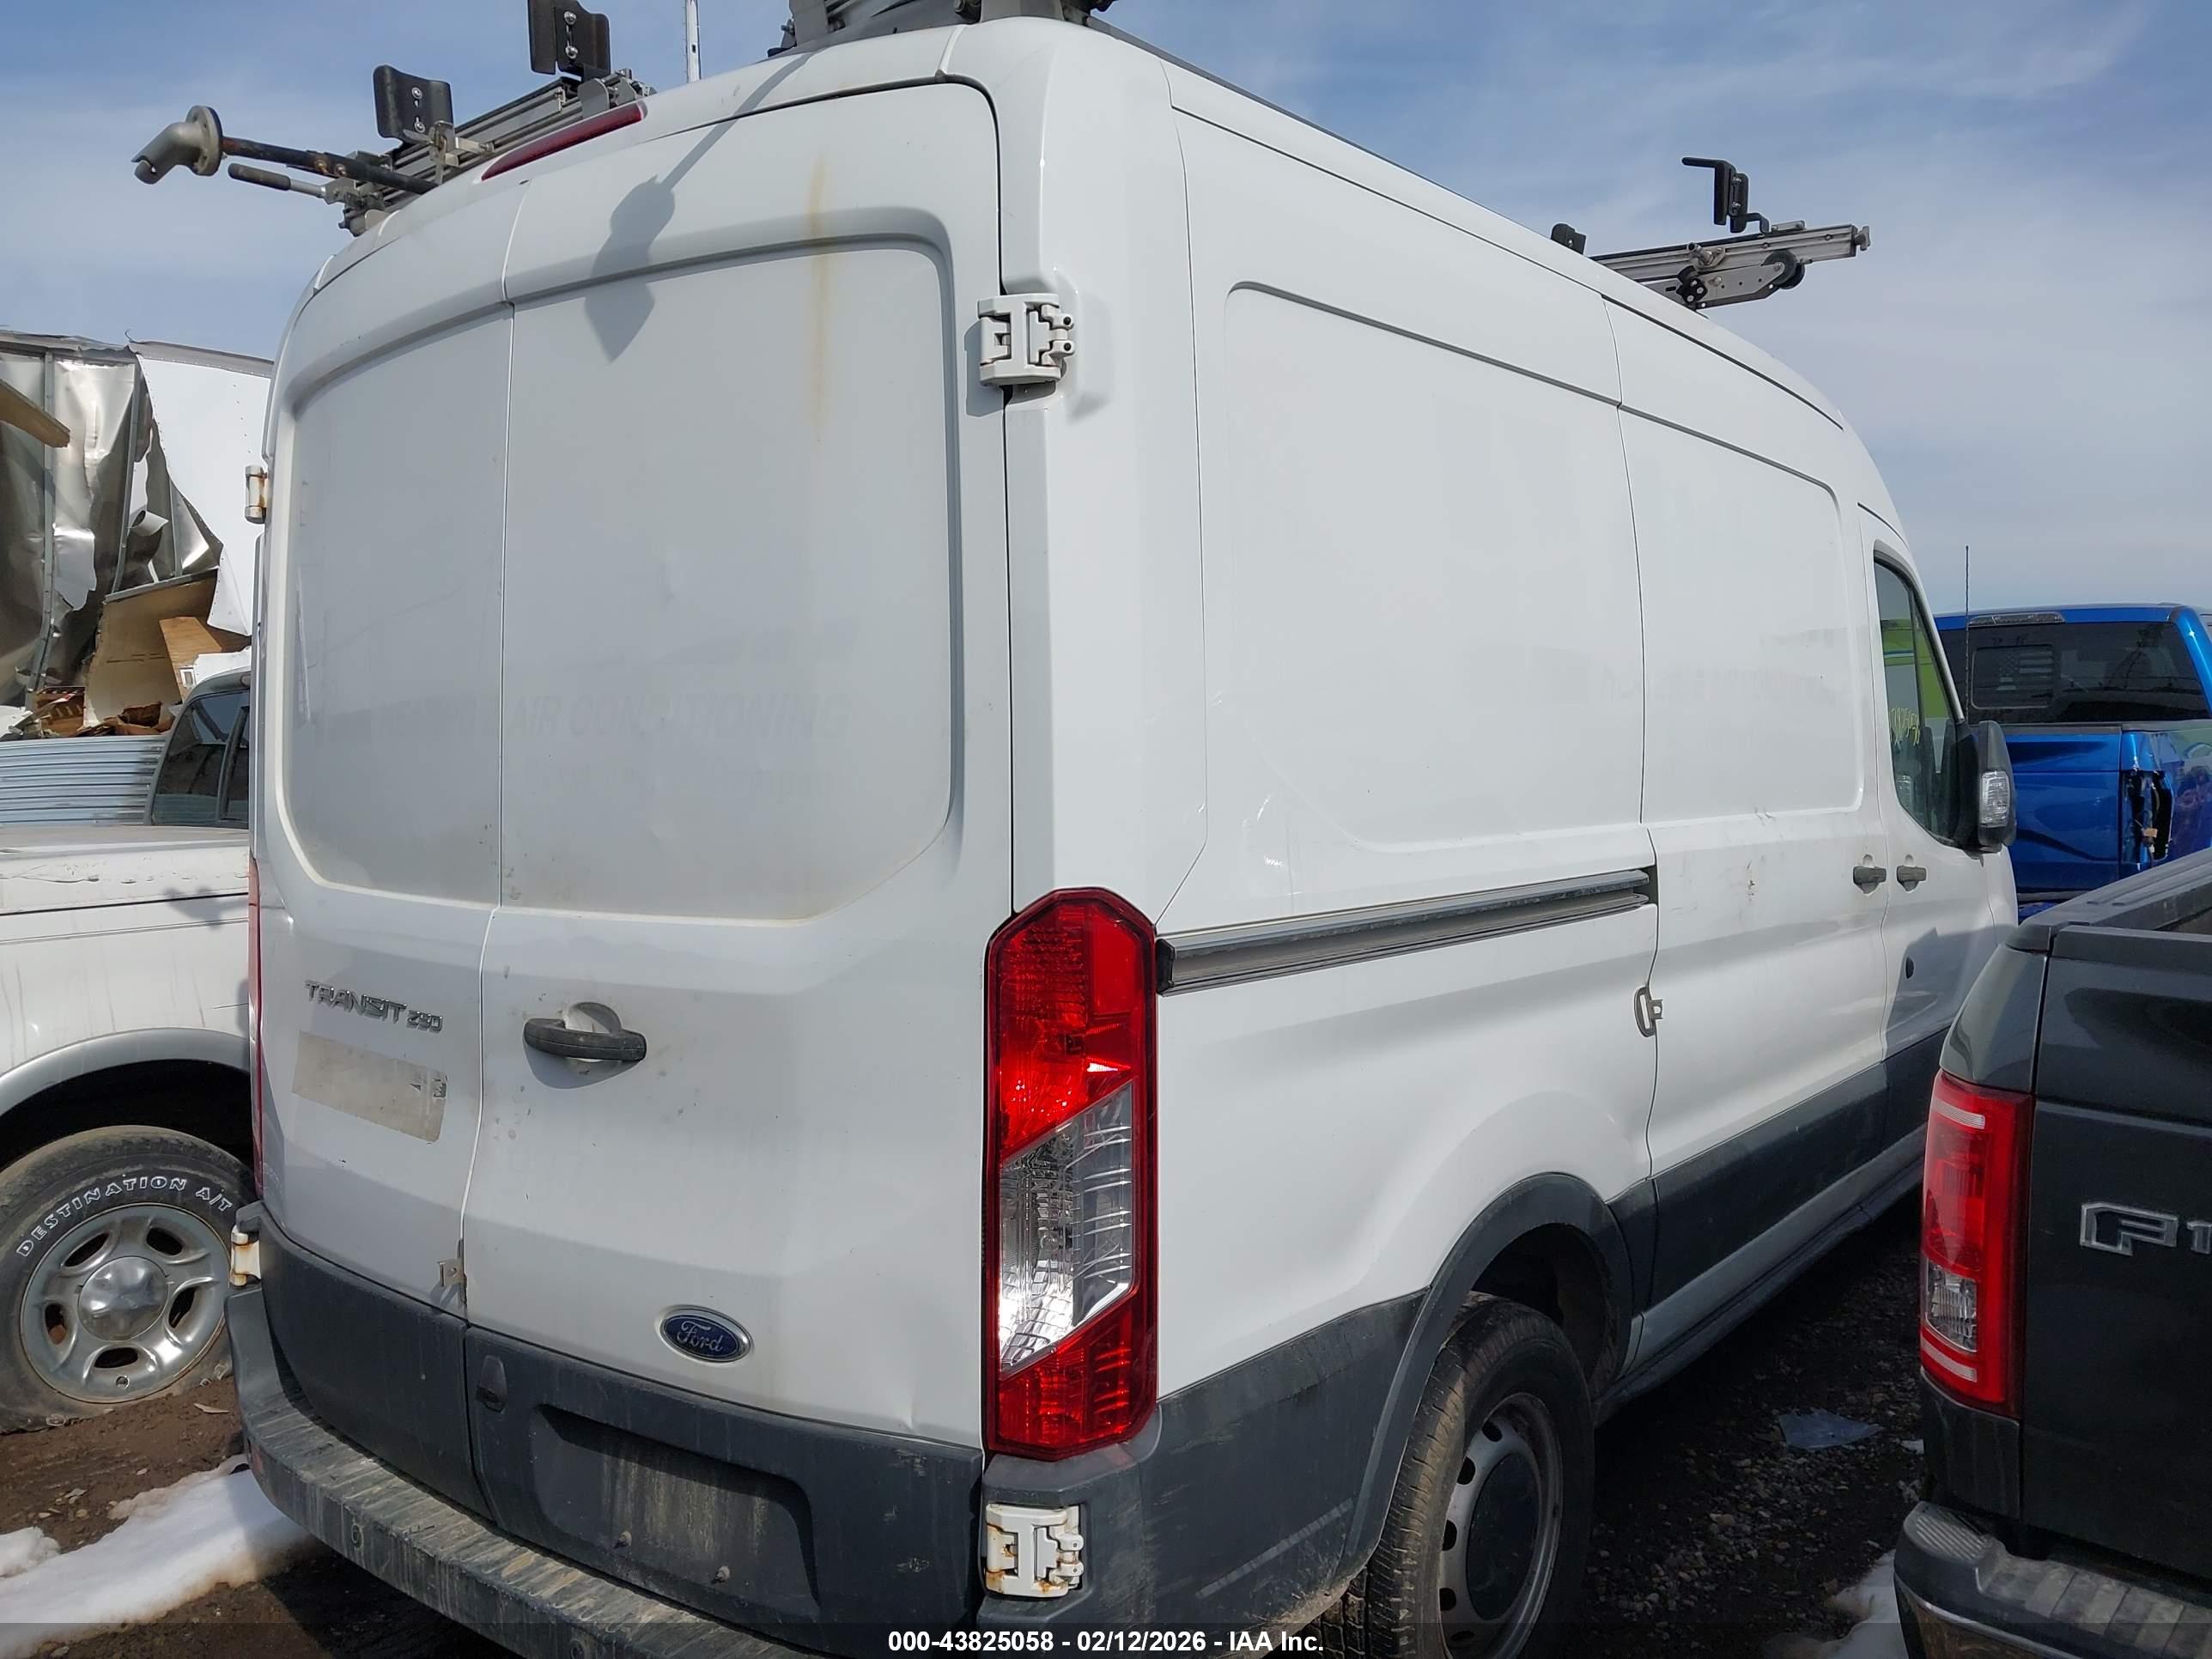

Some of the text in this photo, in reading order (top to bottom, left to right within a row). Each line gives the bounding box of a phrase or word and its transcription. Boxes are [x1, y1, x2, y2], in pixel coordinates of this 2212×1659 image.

[306, 981, 407, 1024] TRANSIT
[16, 1176, 233, 1257] DESTINATION A/T
[677, 1321, 724, 1352] Ford
